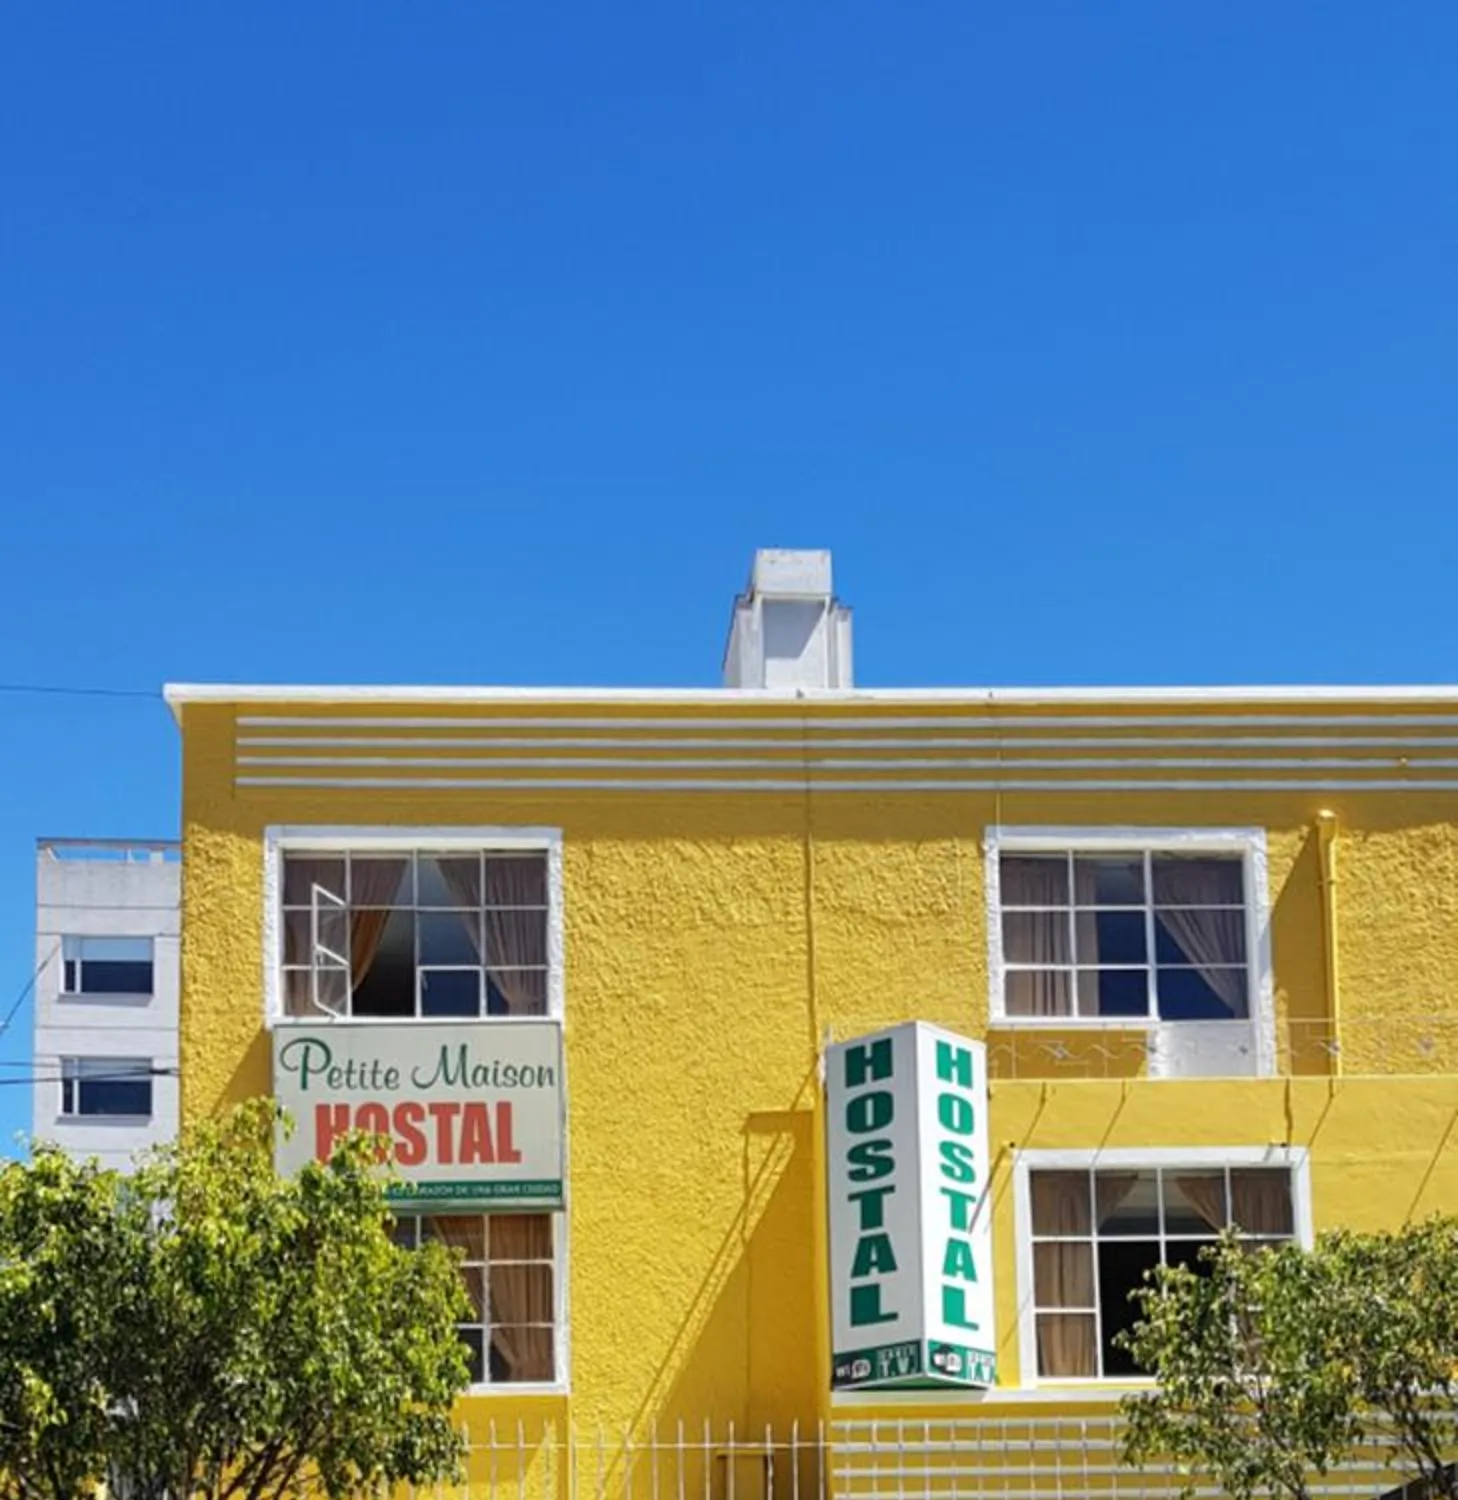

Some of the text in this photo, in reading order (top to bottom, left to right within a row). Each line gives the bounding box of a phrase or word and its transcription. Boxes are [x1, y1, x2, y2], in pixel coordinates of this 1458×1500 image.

[280, 1037, 555, 1090] Petite Maison
[315, 1100, 522, 1167] HOSTAL
[845, 1037, 899, 1328] HOSTAL
[936, 1039, 980, 1331] HOSTAL
